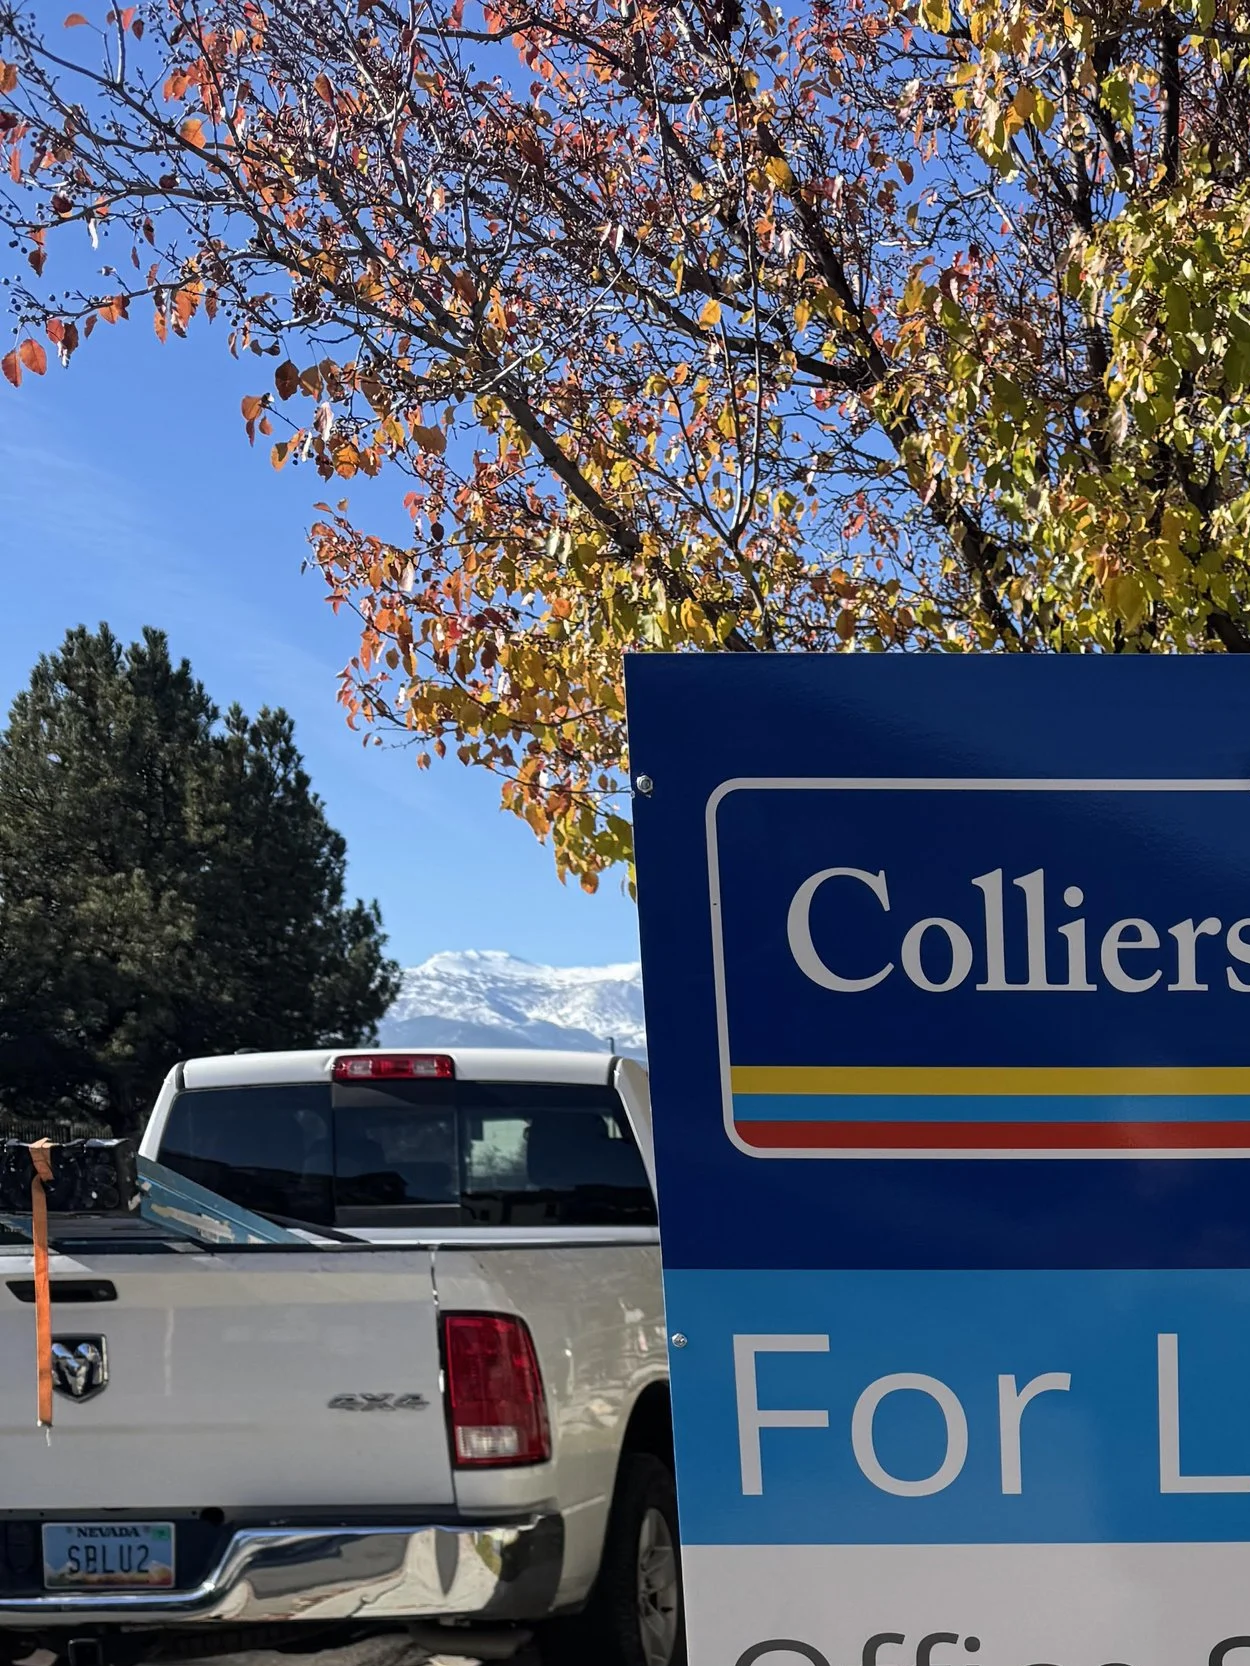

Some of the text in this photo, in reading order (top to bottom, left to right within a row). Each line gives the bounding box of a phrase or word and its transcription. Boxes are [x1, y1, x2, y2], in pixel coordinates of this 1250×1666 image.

[734, 1335, 1071, 1496] For
[77, 1526, 140, 1538] NEVADA
[67, 1544, 149, 1574] SBLU2
